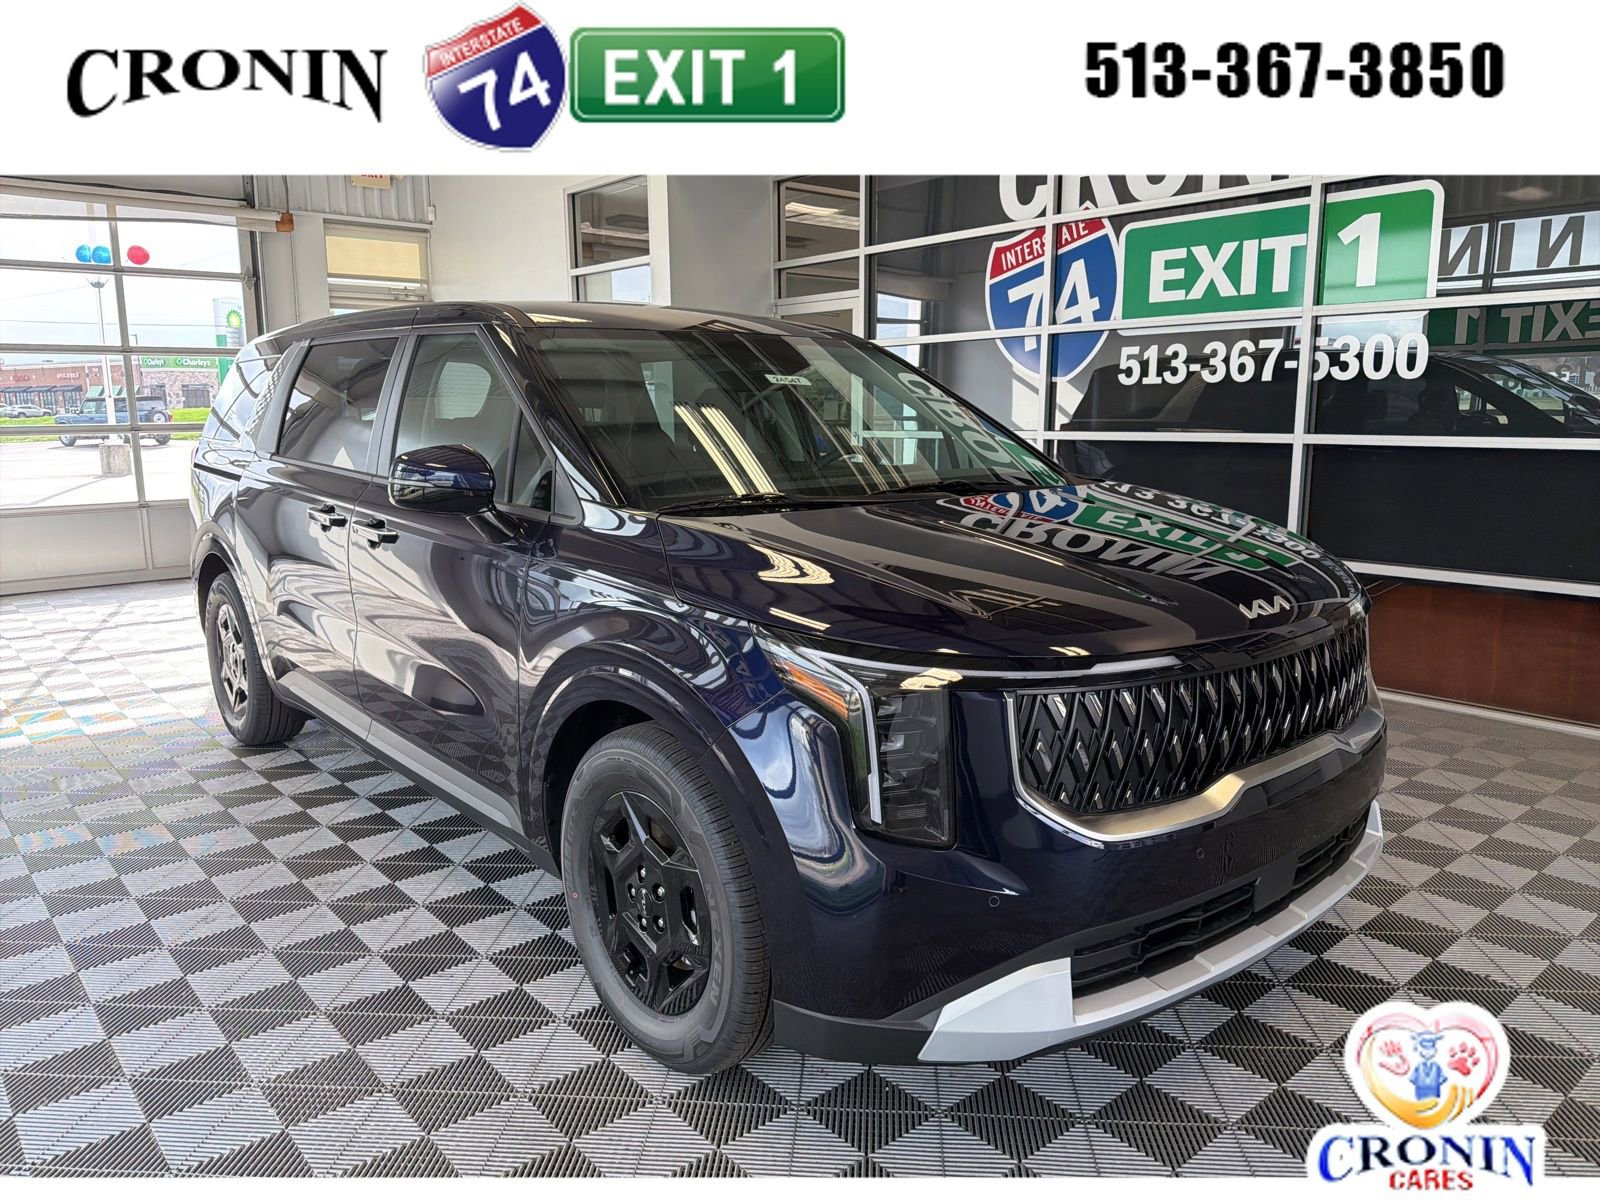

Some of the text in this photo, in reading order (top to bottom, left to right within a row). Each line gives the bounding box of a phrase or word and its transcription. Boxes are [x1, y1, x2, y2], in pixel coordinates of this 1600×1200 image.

[1148, 211, 1382, 304] EXIT 1
[1007, 258, 1100, 352] 74
[1117, 332, 1429, 386] 513-367-5300
